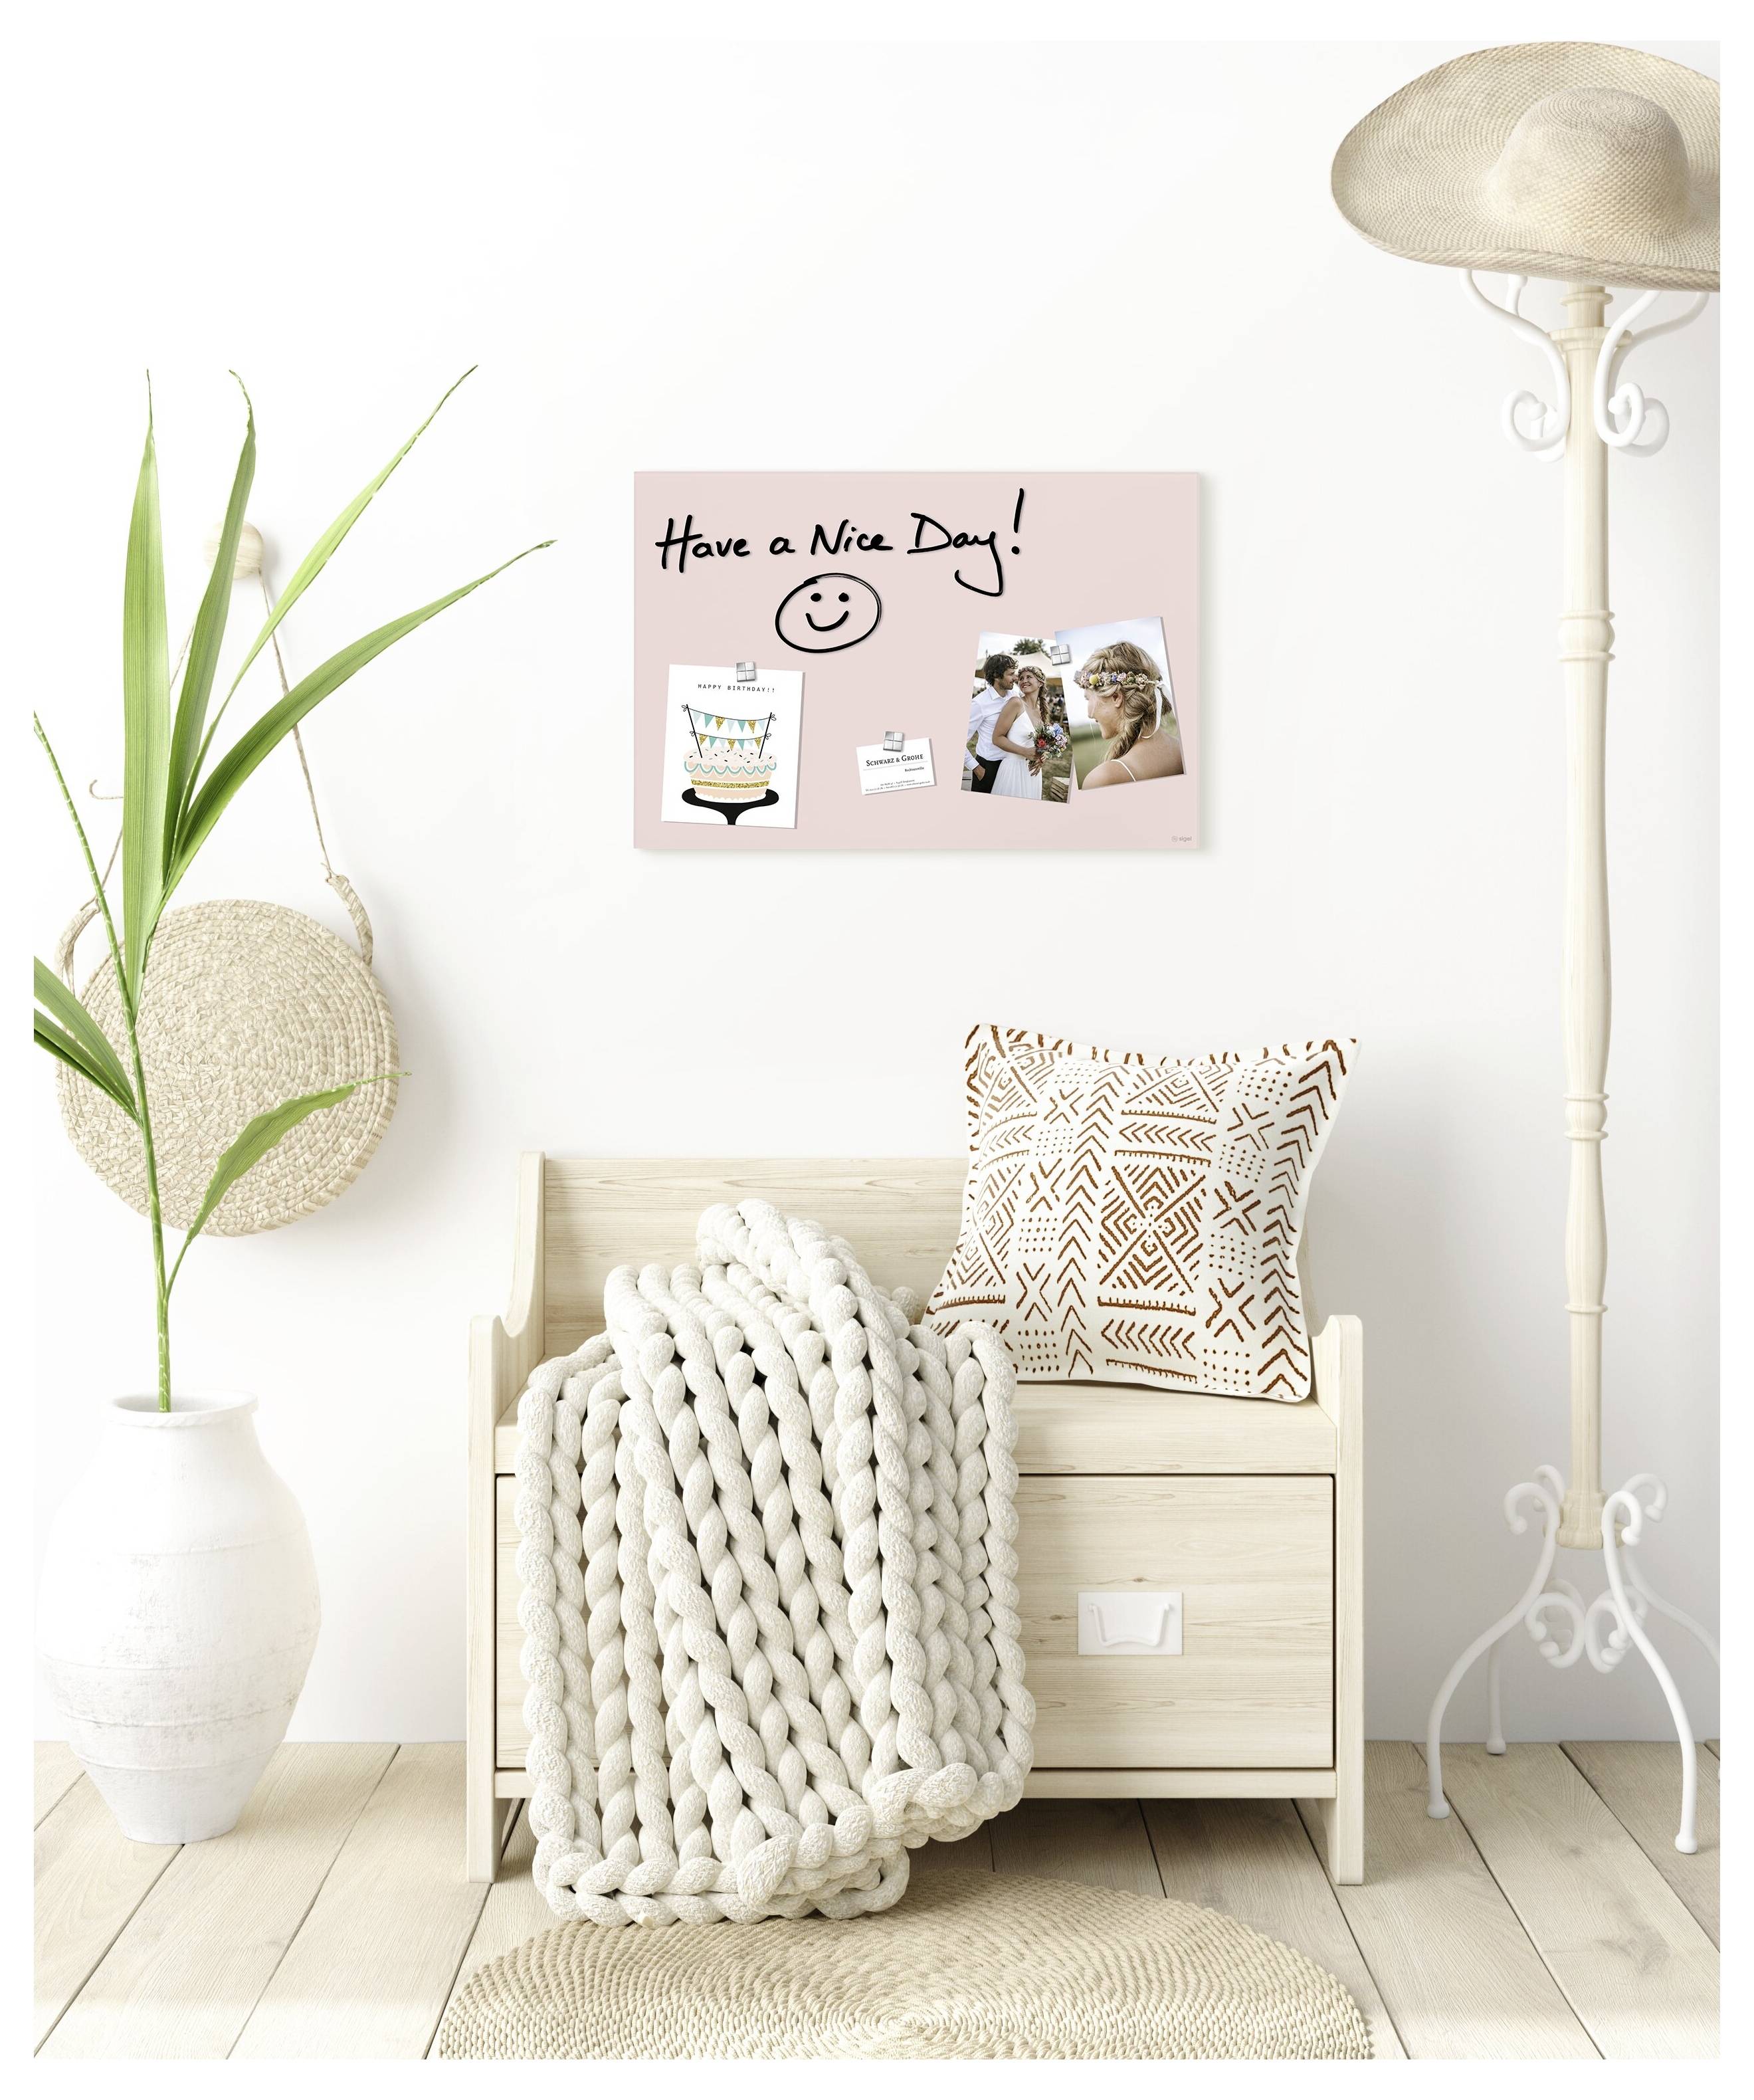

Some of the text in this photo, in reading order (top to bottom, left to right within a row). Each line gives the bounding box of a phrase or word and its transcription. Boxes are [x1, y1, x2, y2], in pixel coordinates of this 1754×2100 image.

[654, 487, 1025, 597] Have a Nice Day!
